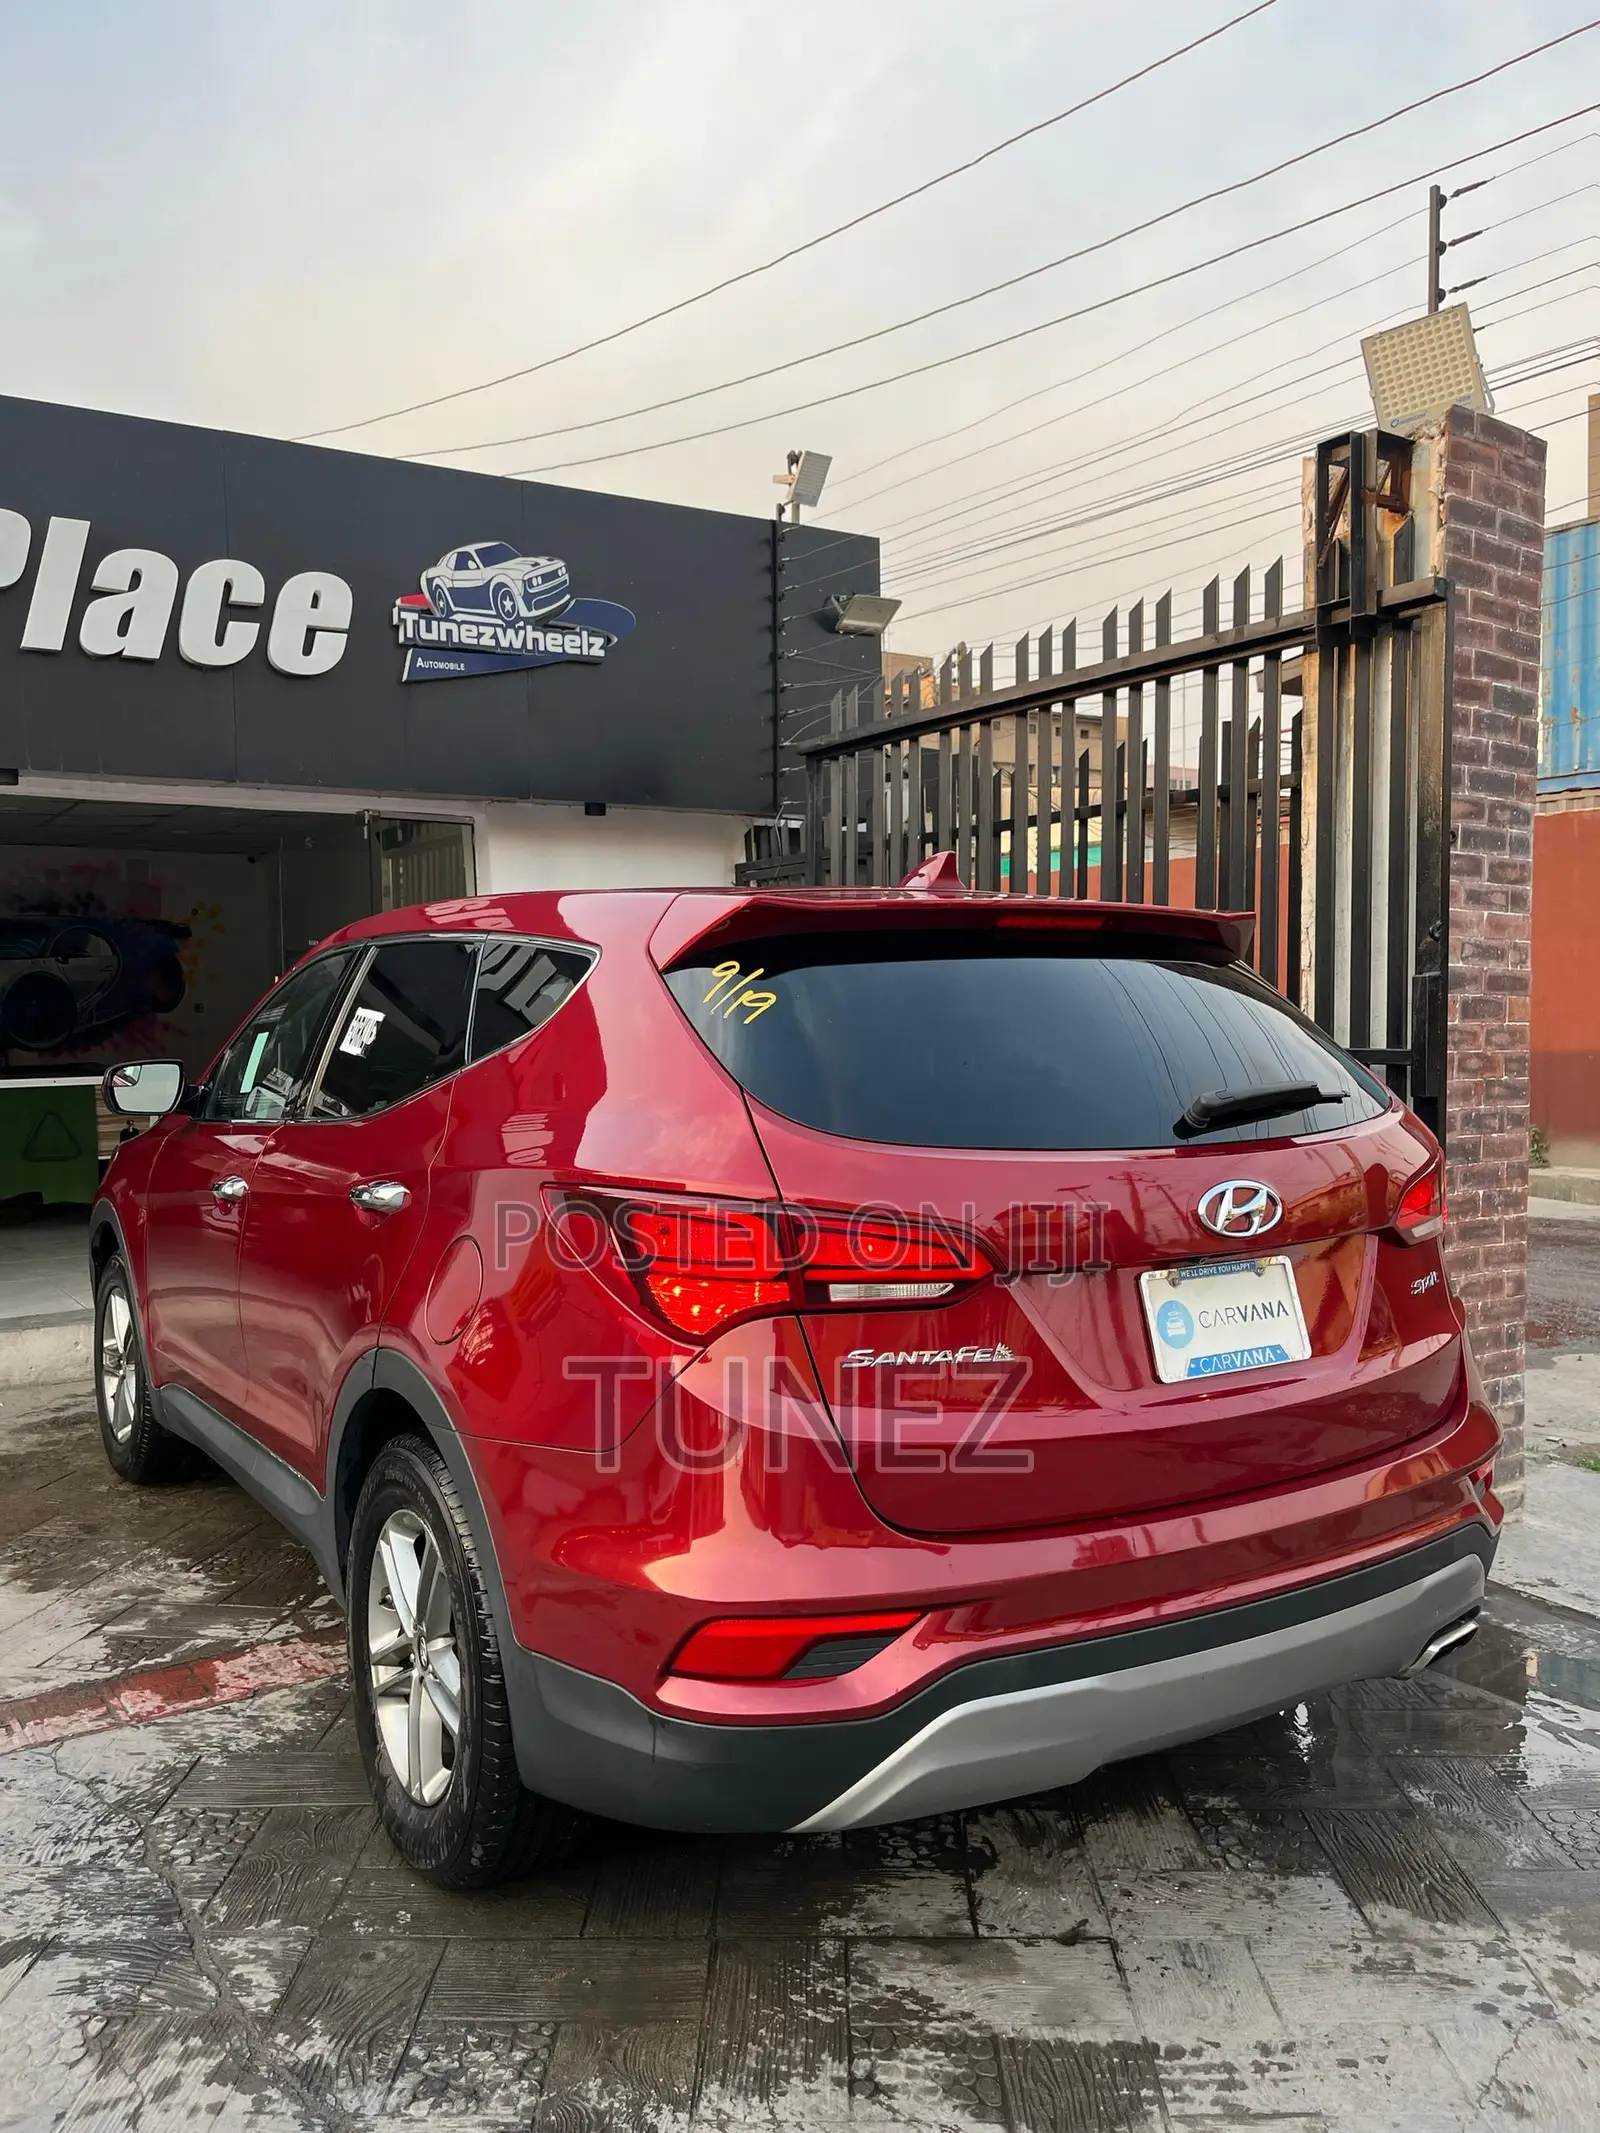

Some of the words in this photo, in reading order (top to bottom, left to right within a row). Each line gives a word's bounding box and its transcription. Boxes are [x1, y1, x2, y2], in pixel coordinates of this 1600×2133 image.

[401, 611, 605, 657] Tunezwheelz
[703, 961, 777, 1024] 9/19
[1198, 1265, 1217, 1275] DRIVE
[1217, 1264, 1231, 1273] YOU
[1198, 1300, 1289, 1328] CARVANA
[1200, 1347, 1275, 1373] CARVANA
